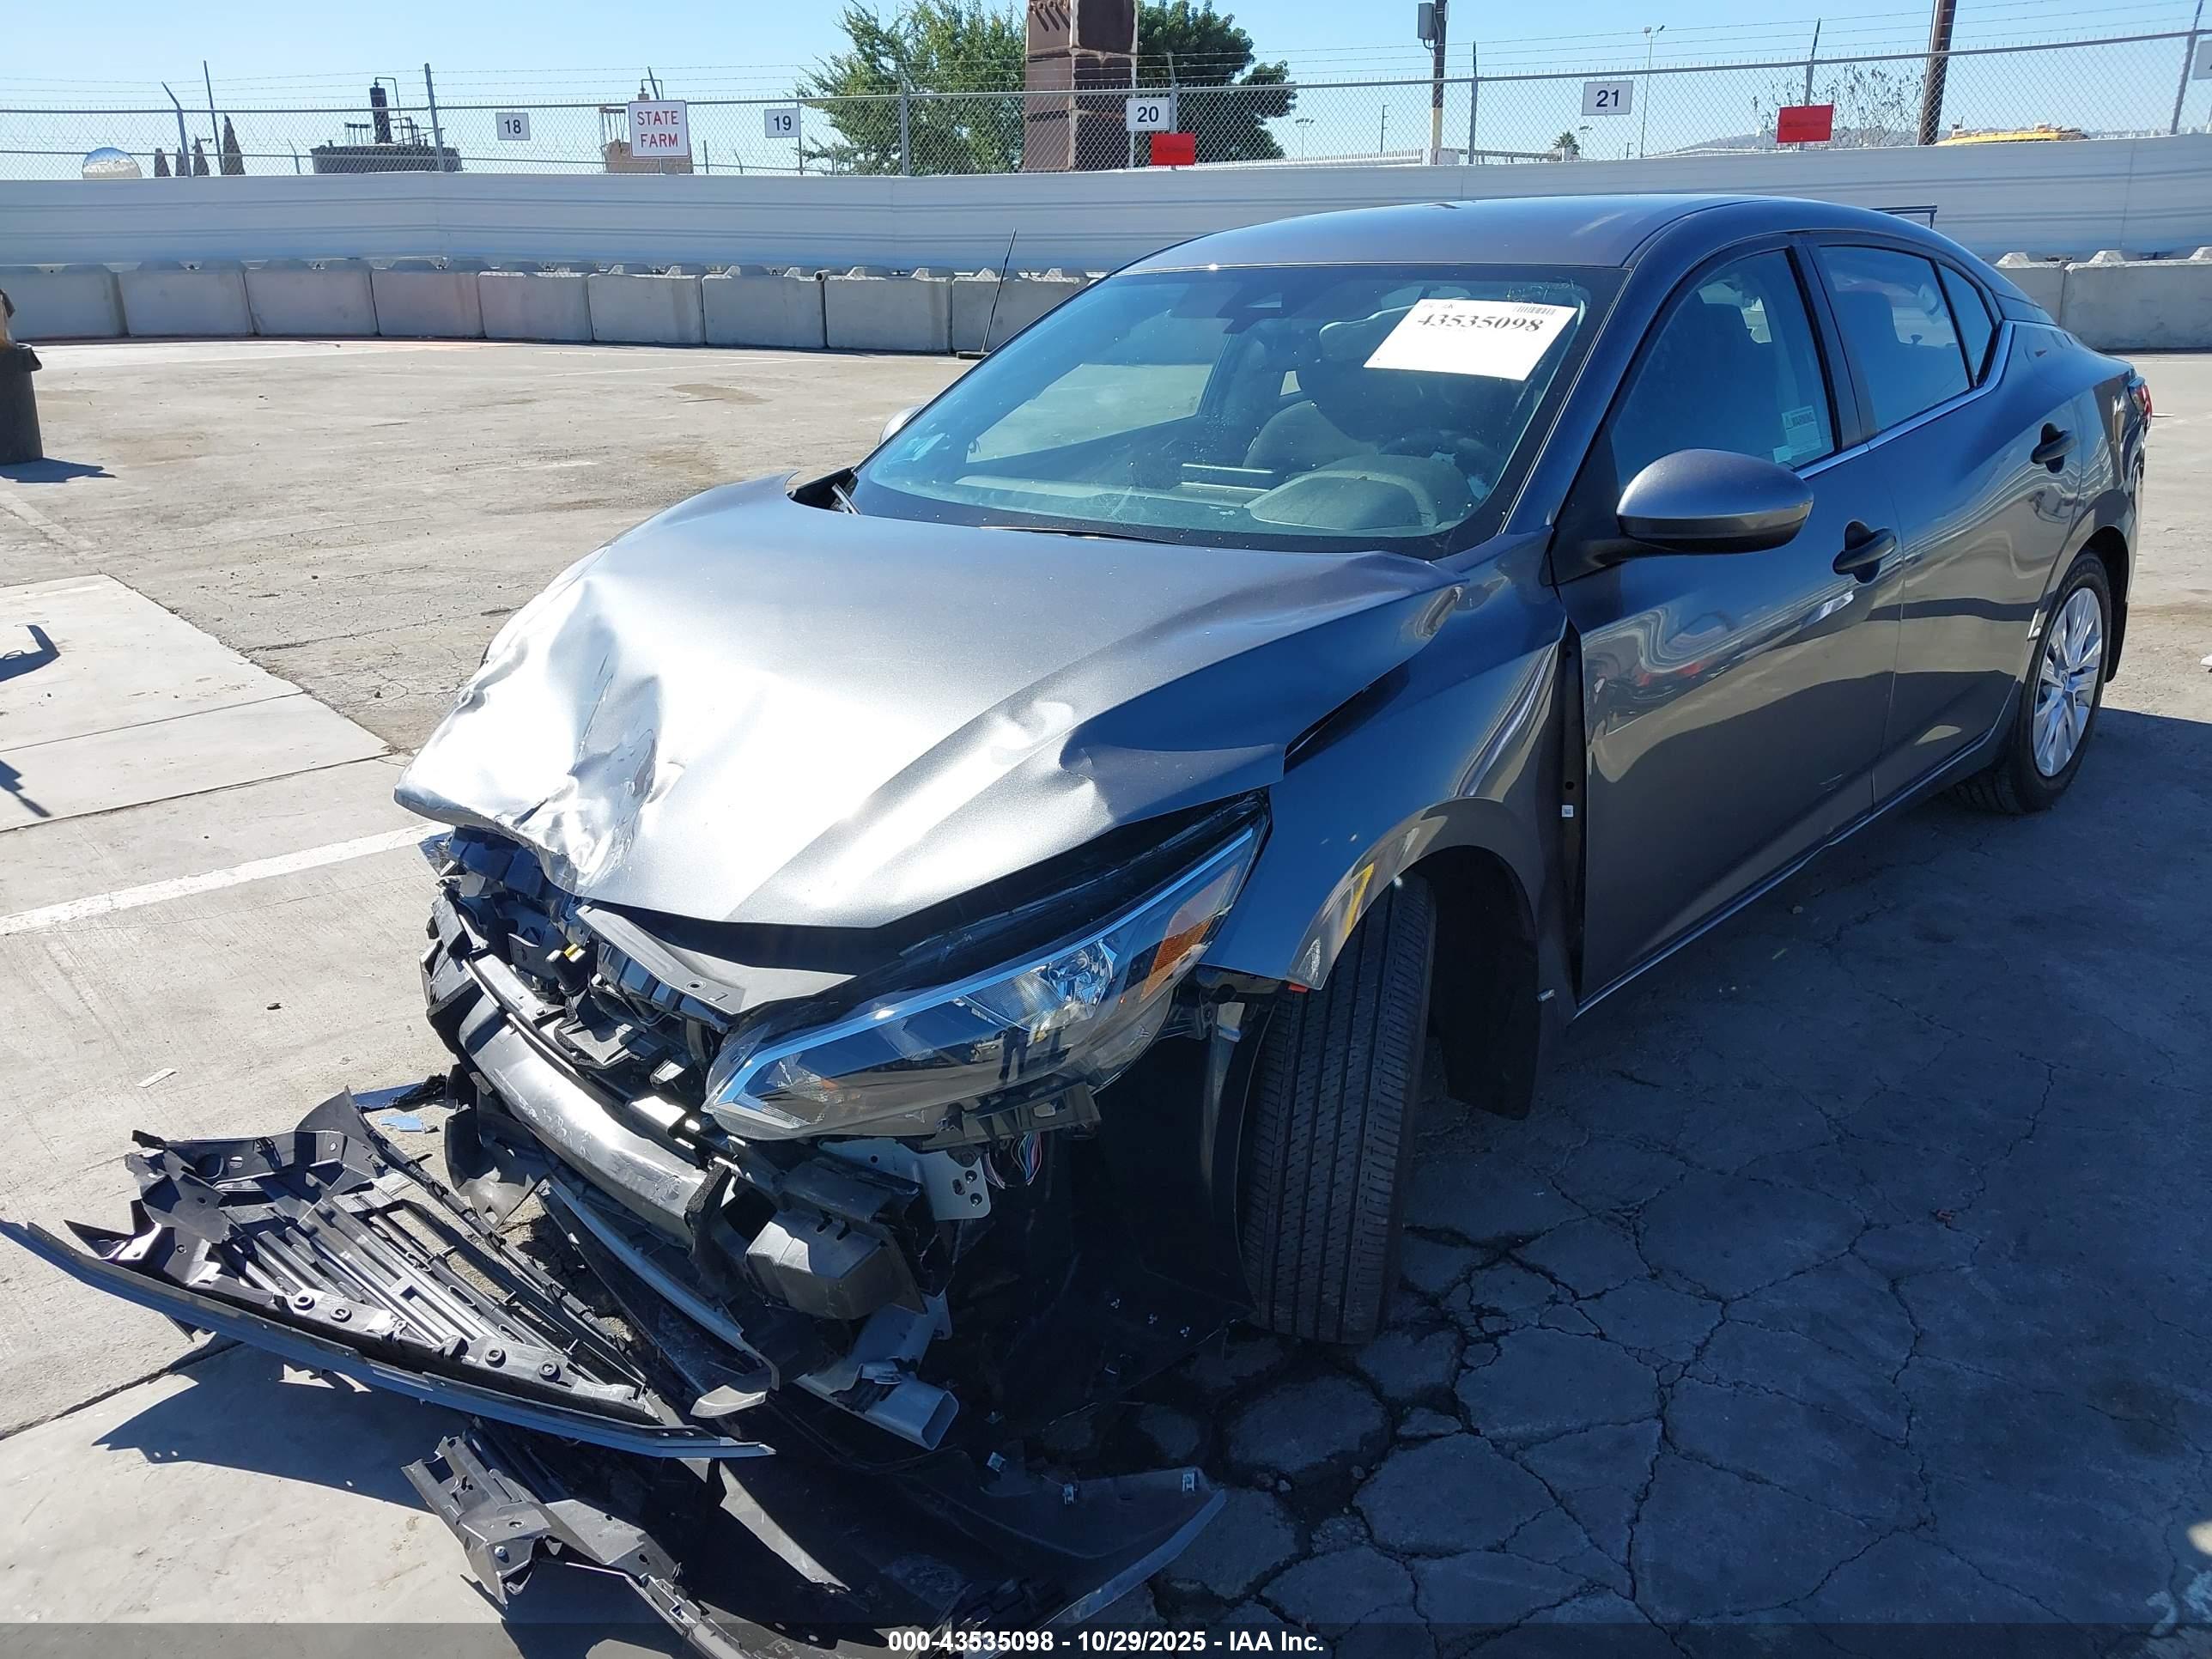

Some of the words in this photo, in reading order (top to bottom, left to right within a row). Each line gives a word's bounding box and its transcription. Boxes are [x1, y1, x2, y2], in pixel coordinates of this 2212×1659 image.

[1595, 88, 1620, 107] 21
[636, 110, 680, 126] STATE
[773, 115, 792, 131] 19
[1136, 106, 1159, 123] 20
[504, 118, 522, 135] 18
[640, 132, 678, 149] FARM
[1418, 313, 1544, 332] 43535098
